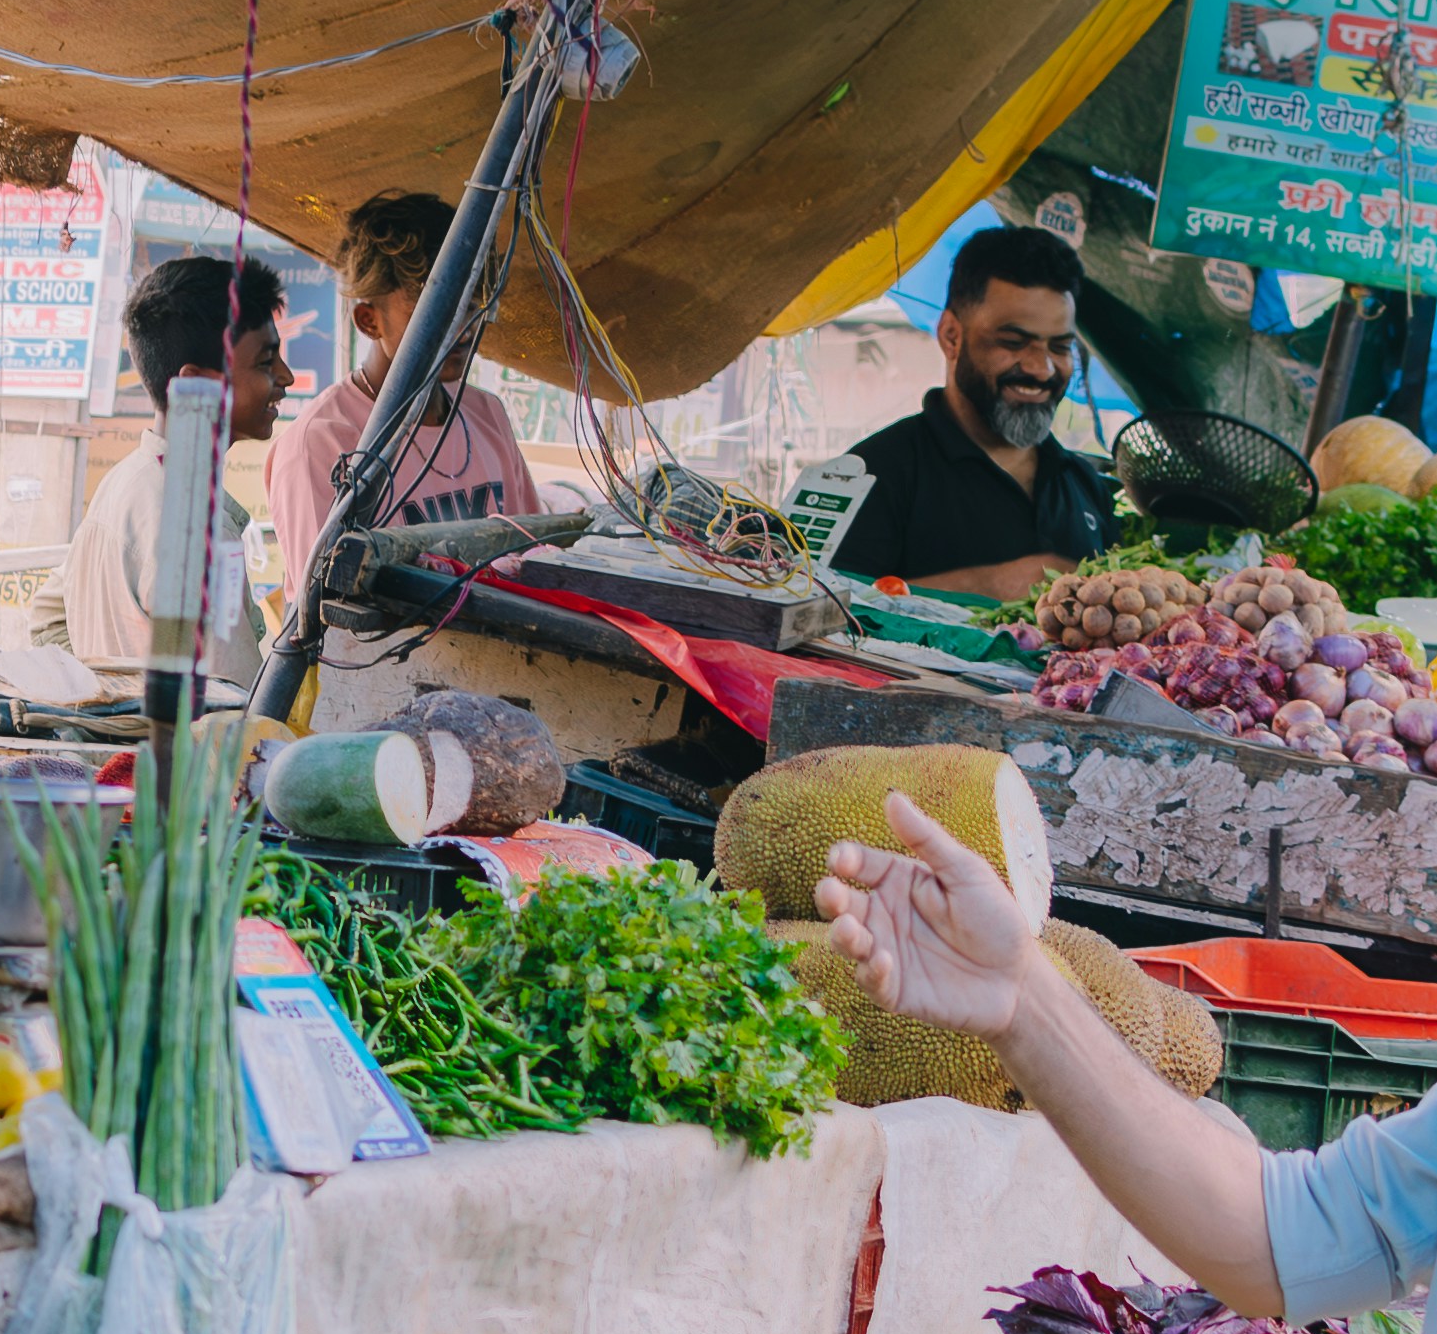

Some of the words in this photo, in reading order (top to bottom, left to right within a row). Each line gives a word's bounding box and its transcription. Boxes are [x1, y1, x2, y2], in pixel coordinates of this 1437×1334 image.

[1204, 81, 1245, 116] हरी
[1226, 131, 1277, 157] हमारे
[1279, 179, 1353, 218] फ्री
[1186, 206, 1254, 238] दुकान
[16, 282, 90, 303] SCHOOL
